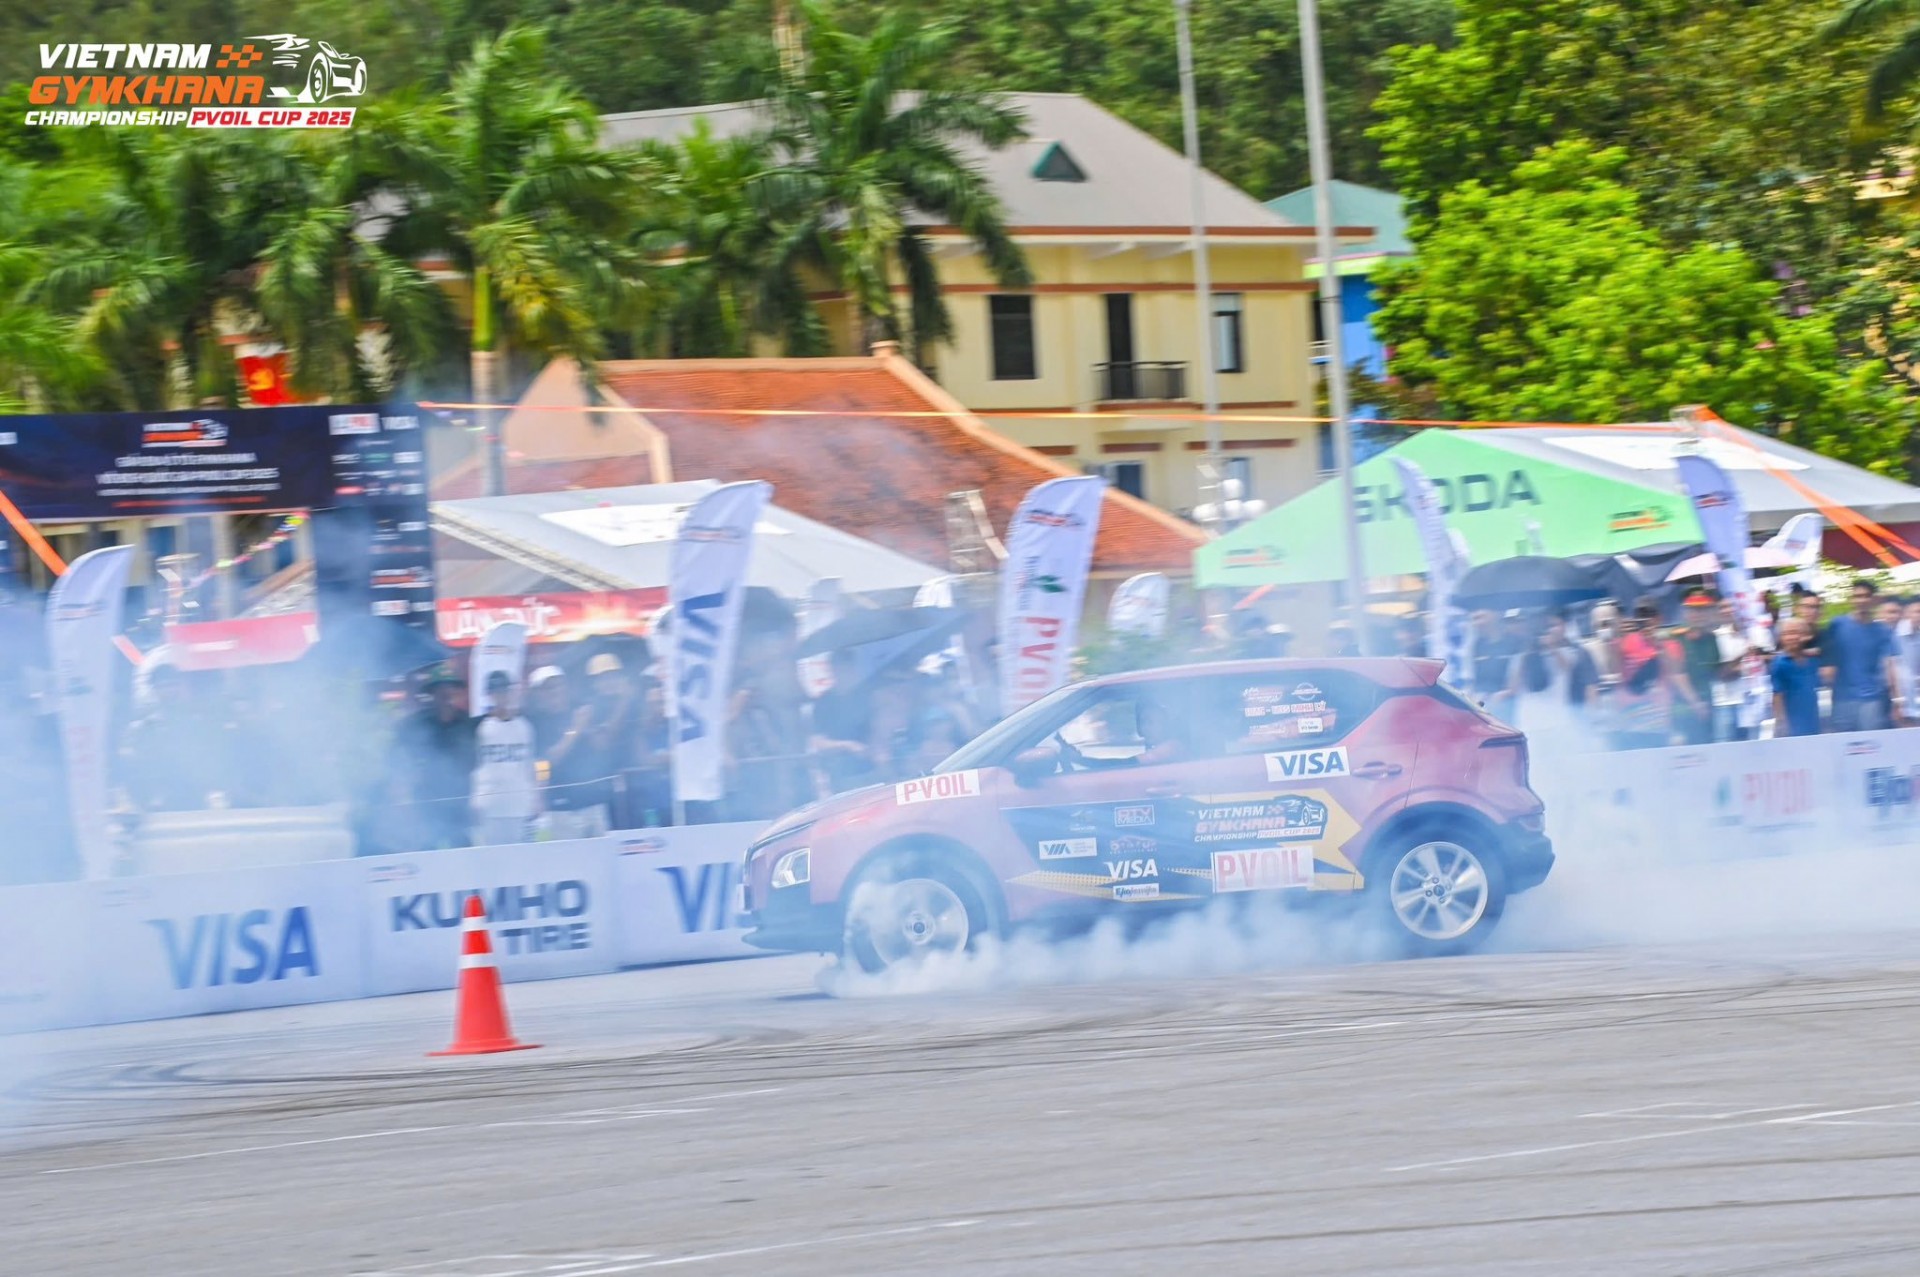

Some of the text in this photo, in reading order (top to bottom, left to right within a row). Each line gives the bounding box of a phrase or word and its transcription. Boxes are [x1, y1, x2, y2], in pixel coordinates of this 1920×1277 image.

[677, 591, 727, 743] VISA
[1017, 616, 1062, 703] PVOI
[1271, 751, 1345, 777] VISA
[903, 773, 972, 802] PVOIL
[1198, 805, 1265, 820] VIETNAM
[1194, 831, 1258, 843] CHAMPIONSHIP
[1103, 858, 1159, 880] VISA
[1217, 849, 1309, 890] PVOIL
[142, 906, 321, 990] VISA
[499, 922, 592, 955] TIRE
